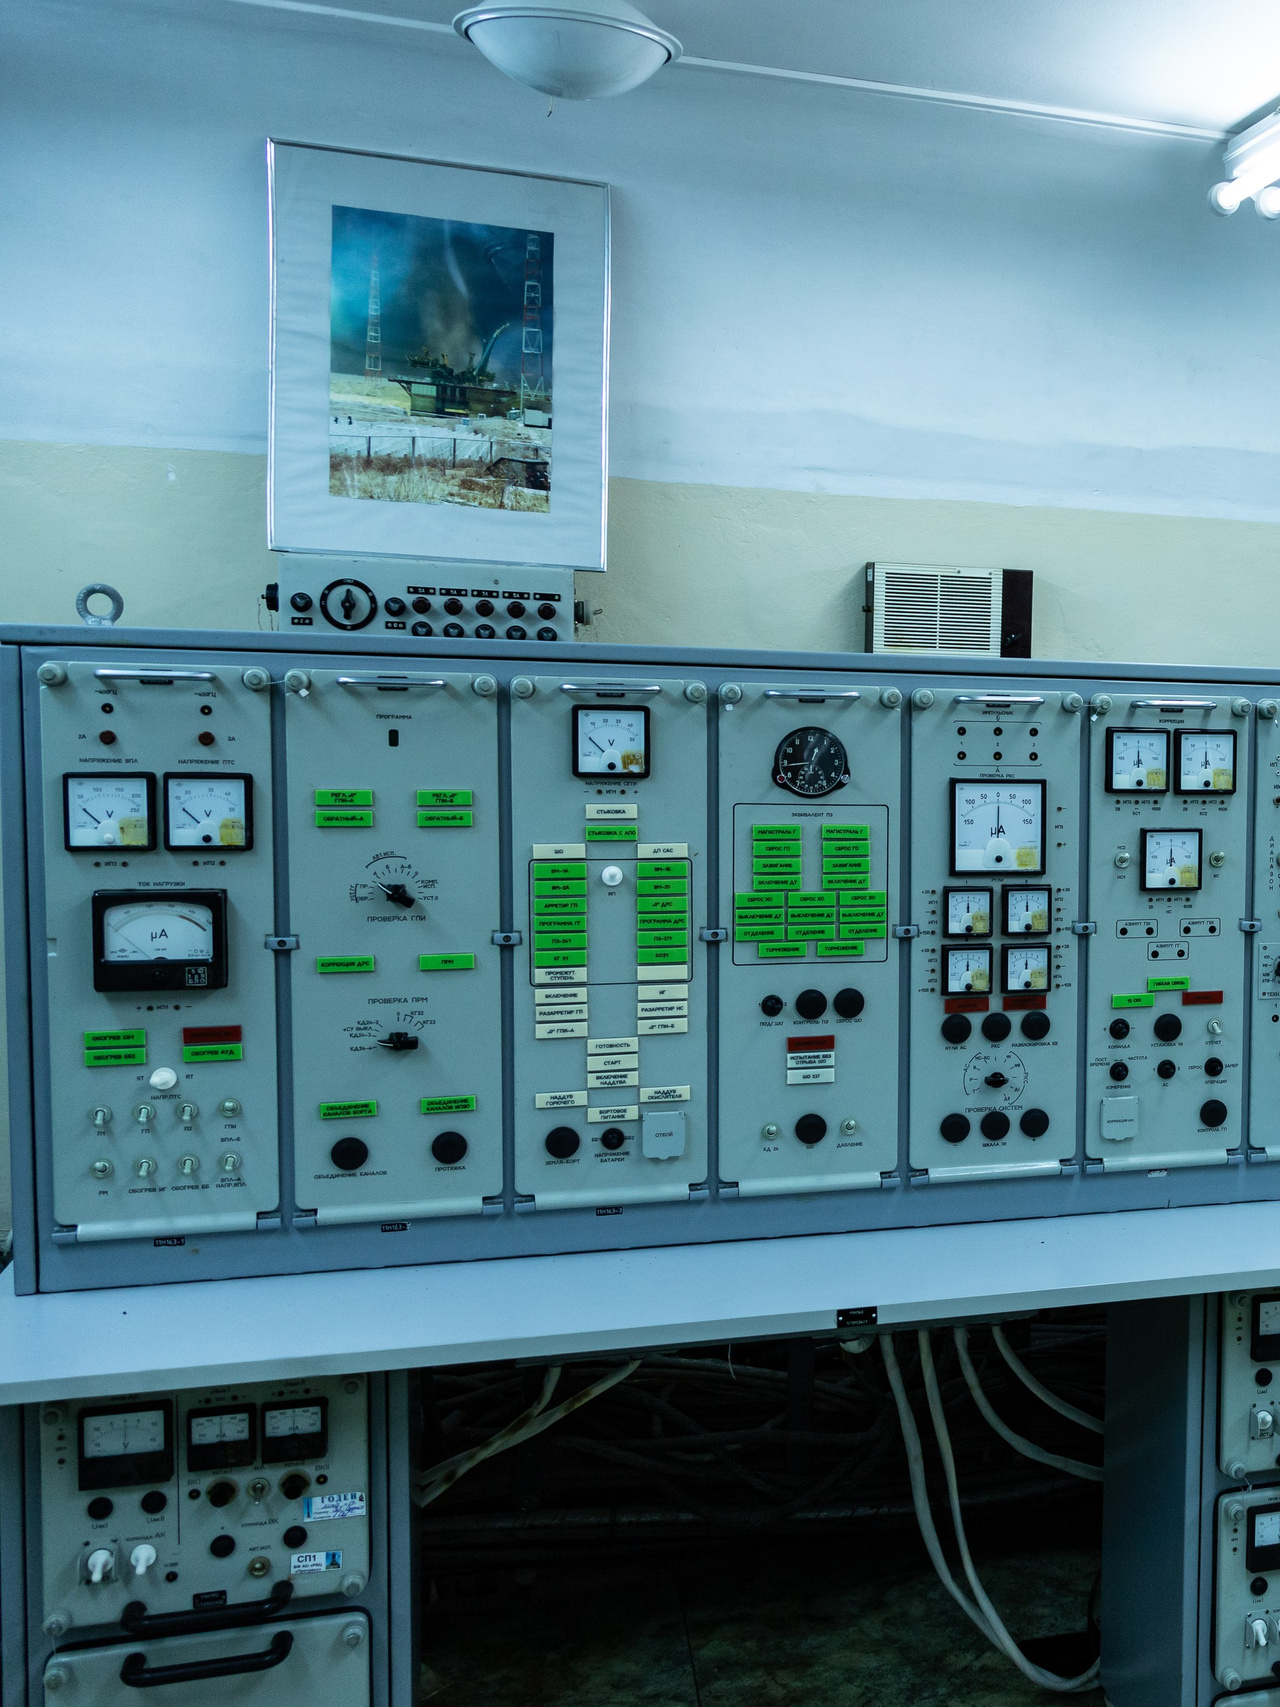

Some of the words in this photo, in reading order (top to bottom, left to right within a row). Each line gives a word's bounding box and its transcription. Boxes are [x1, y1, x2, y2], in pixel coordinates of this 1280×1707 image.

[106, 810, 114, 818] V
[204, 810, 212, 818] V
[297, 1554, 316, 1563] СП1
